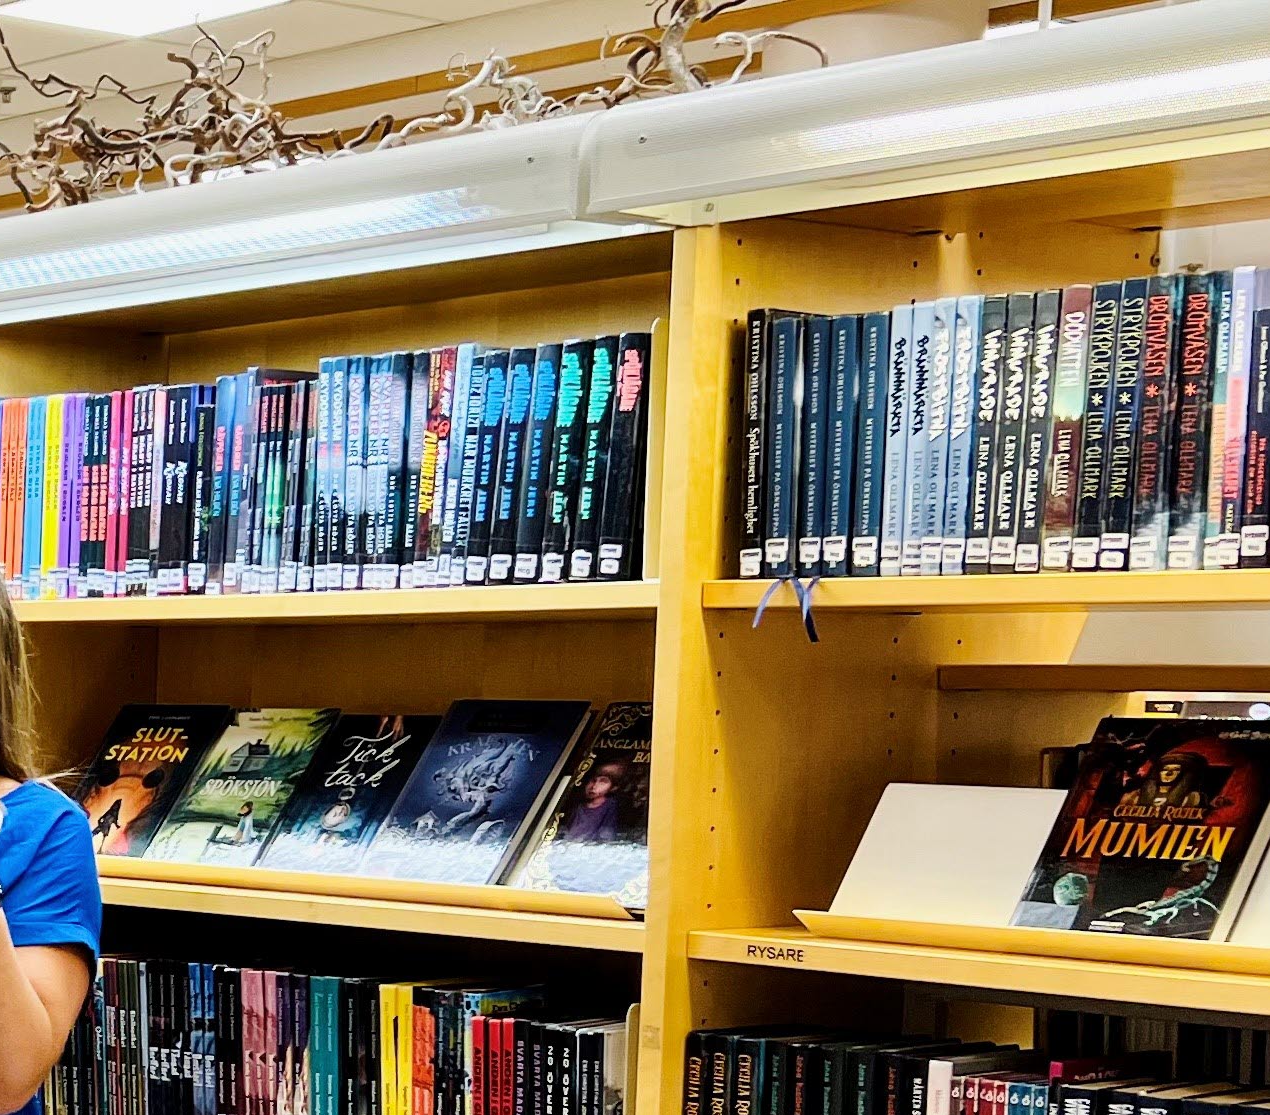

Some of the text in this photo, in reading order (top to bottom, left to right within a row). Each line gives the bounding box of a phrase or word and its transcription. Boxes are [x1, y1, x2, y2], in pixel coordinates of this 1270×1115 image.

[133, 727, 188, 743] SLUT-
[104, 745, 189, 764] STATION
[341, 731, 411, 765] Tick
[200, 777, 282, 798] SPÖKSJÖN
[1113, 804, 1161, 819] CECILIA
[1060, 818, 1236, 862] MUMIEN
[747, 945, 804, 963] RYSARE
